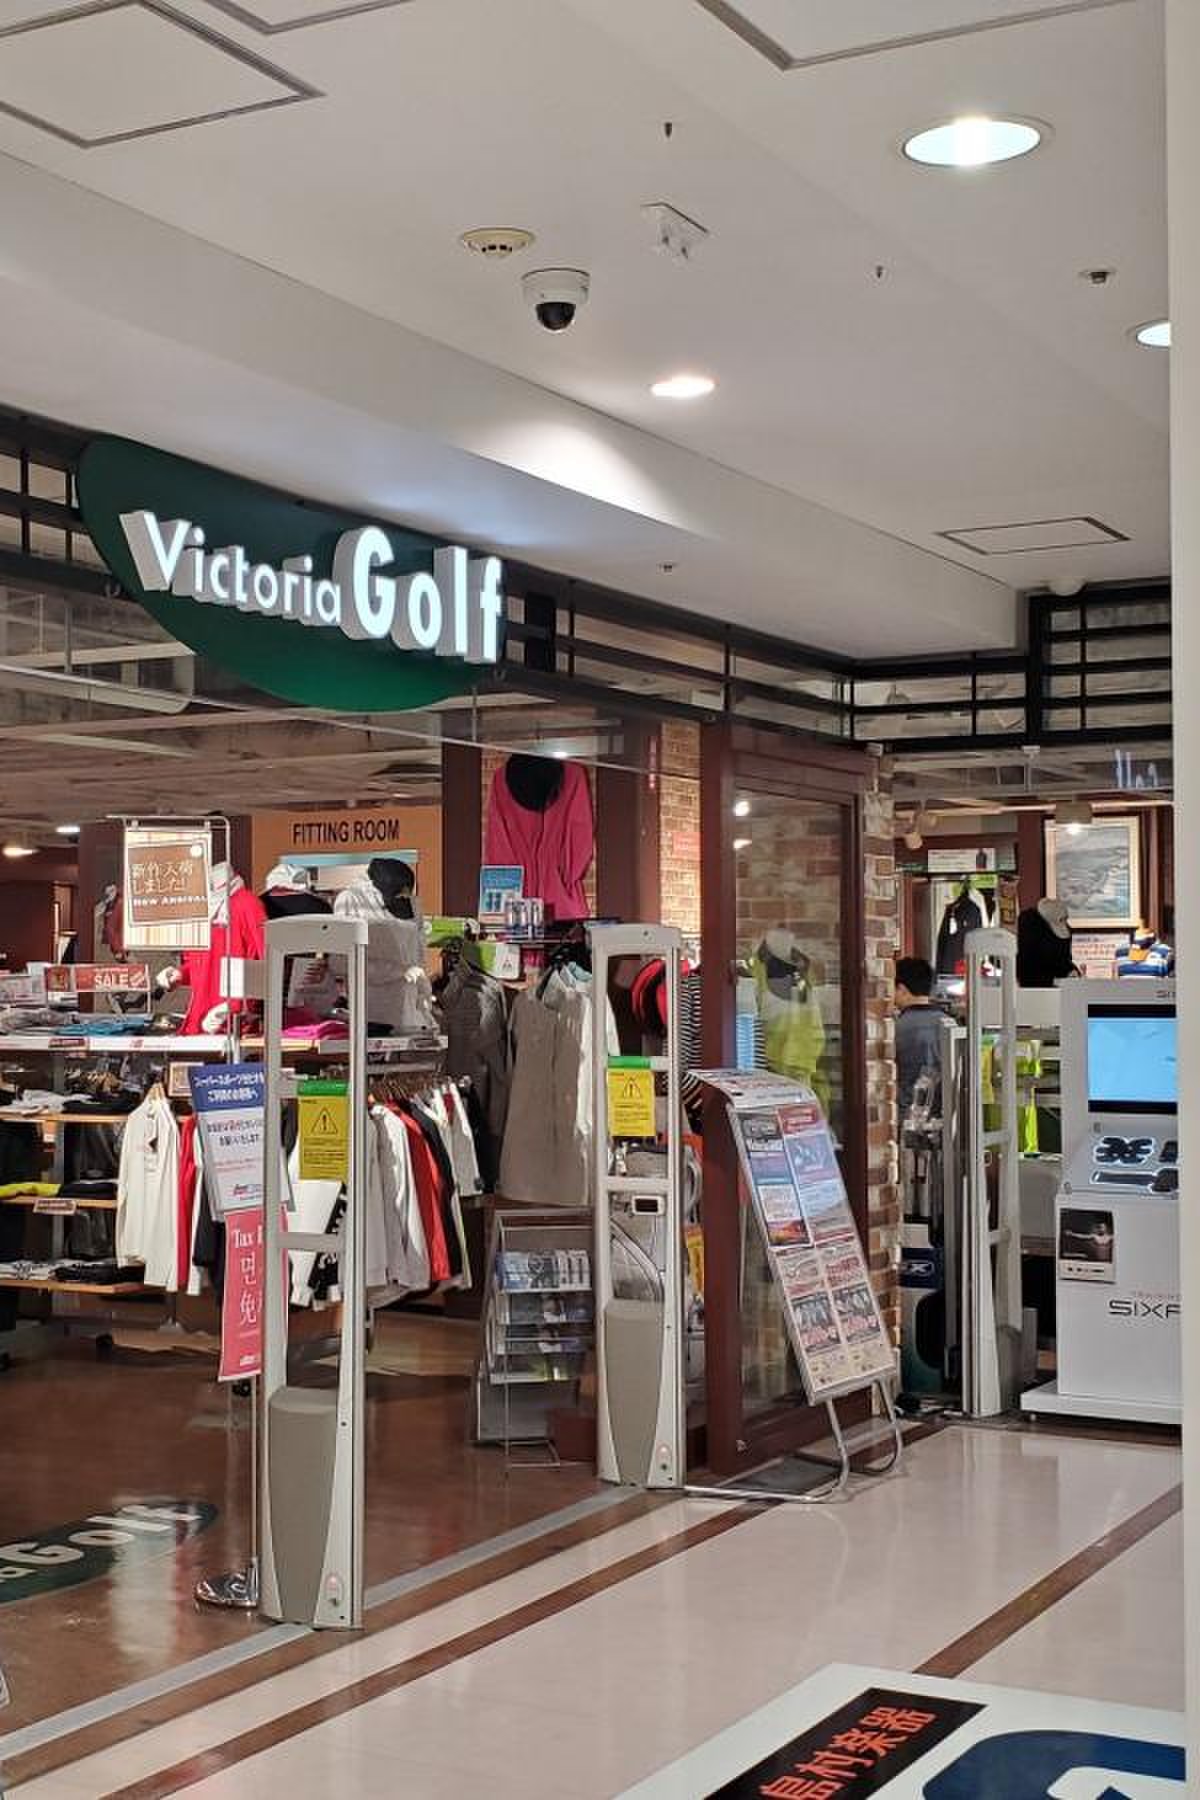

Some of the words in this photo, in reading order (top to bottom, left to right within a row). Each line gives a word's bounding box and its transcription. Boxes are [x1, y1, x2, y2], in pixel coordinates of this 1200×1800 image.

[119, 510, 341, 626] Victoria
[333, 525, 502, 663] Golf
[293, 820, 349, 845] FITTING
[353, 818, 400, 842] ROOM
[95, 973, 129, 987] SALE
[231, 1229, 253, 1249] Tax
[759, 1705, 938, 1800] 島村楽器
